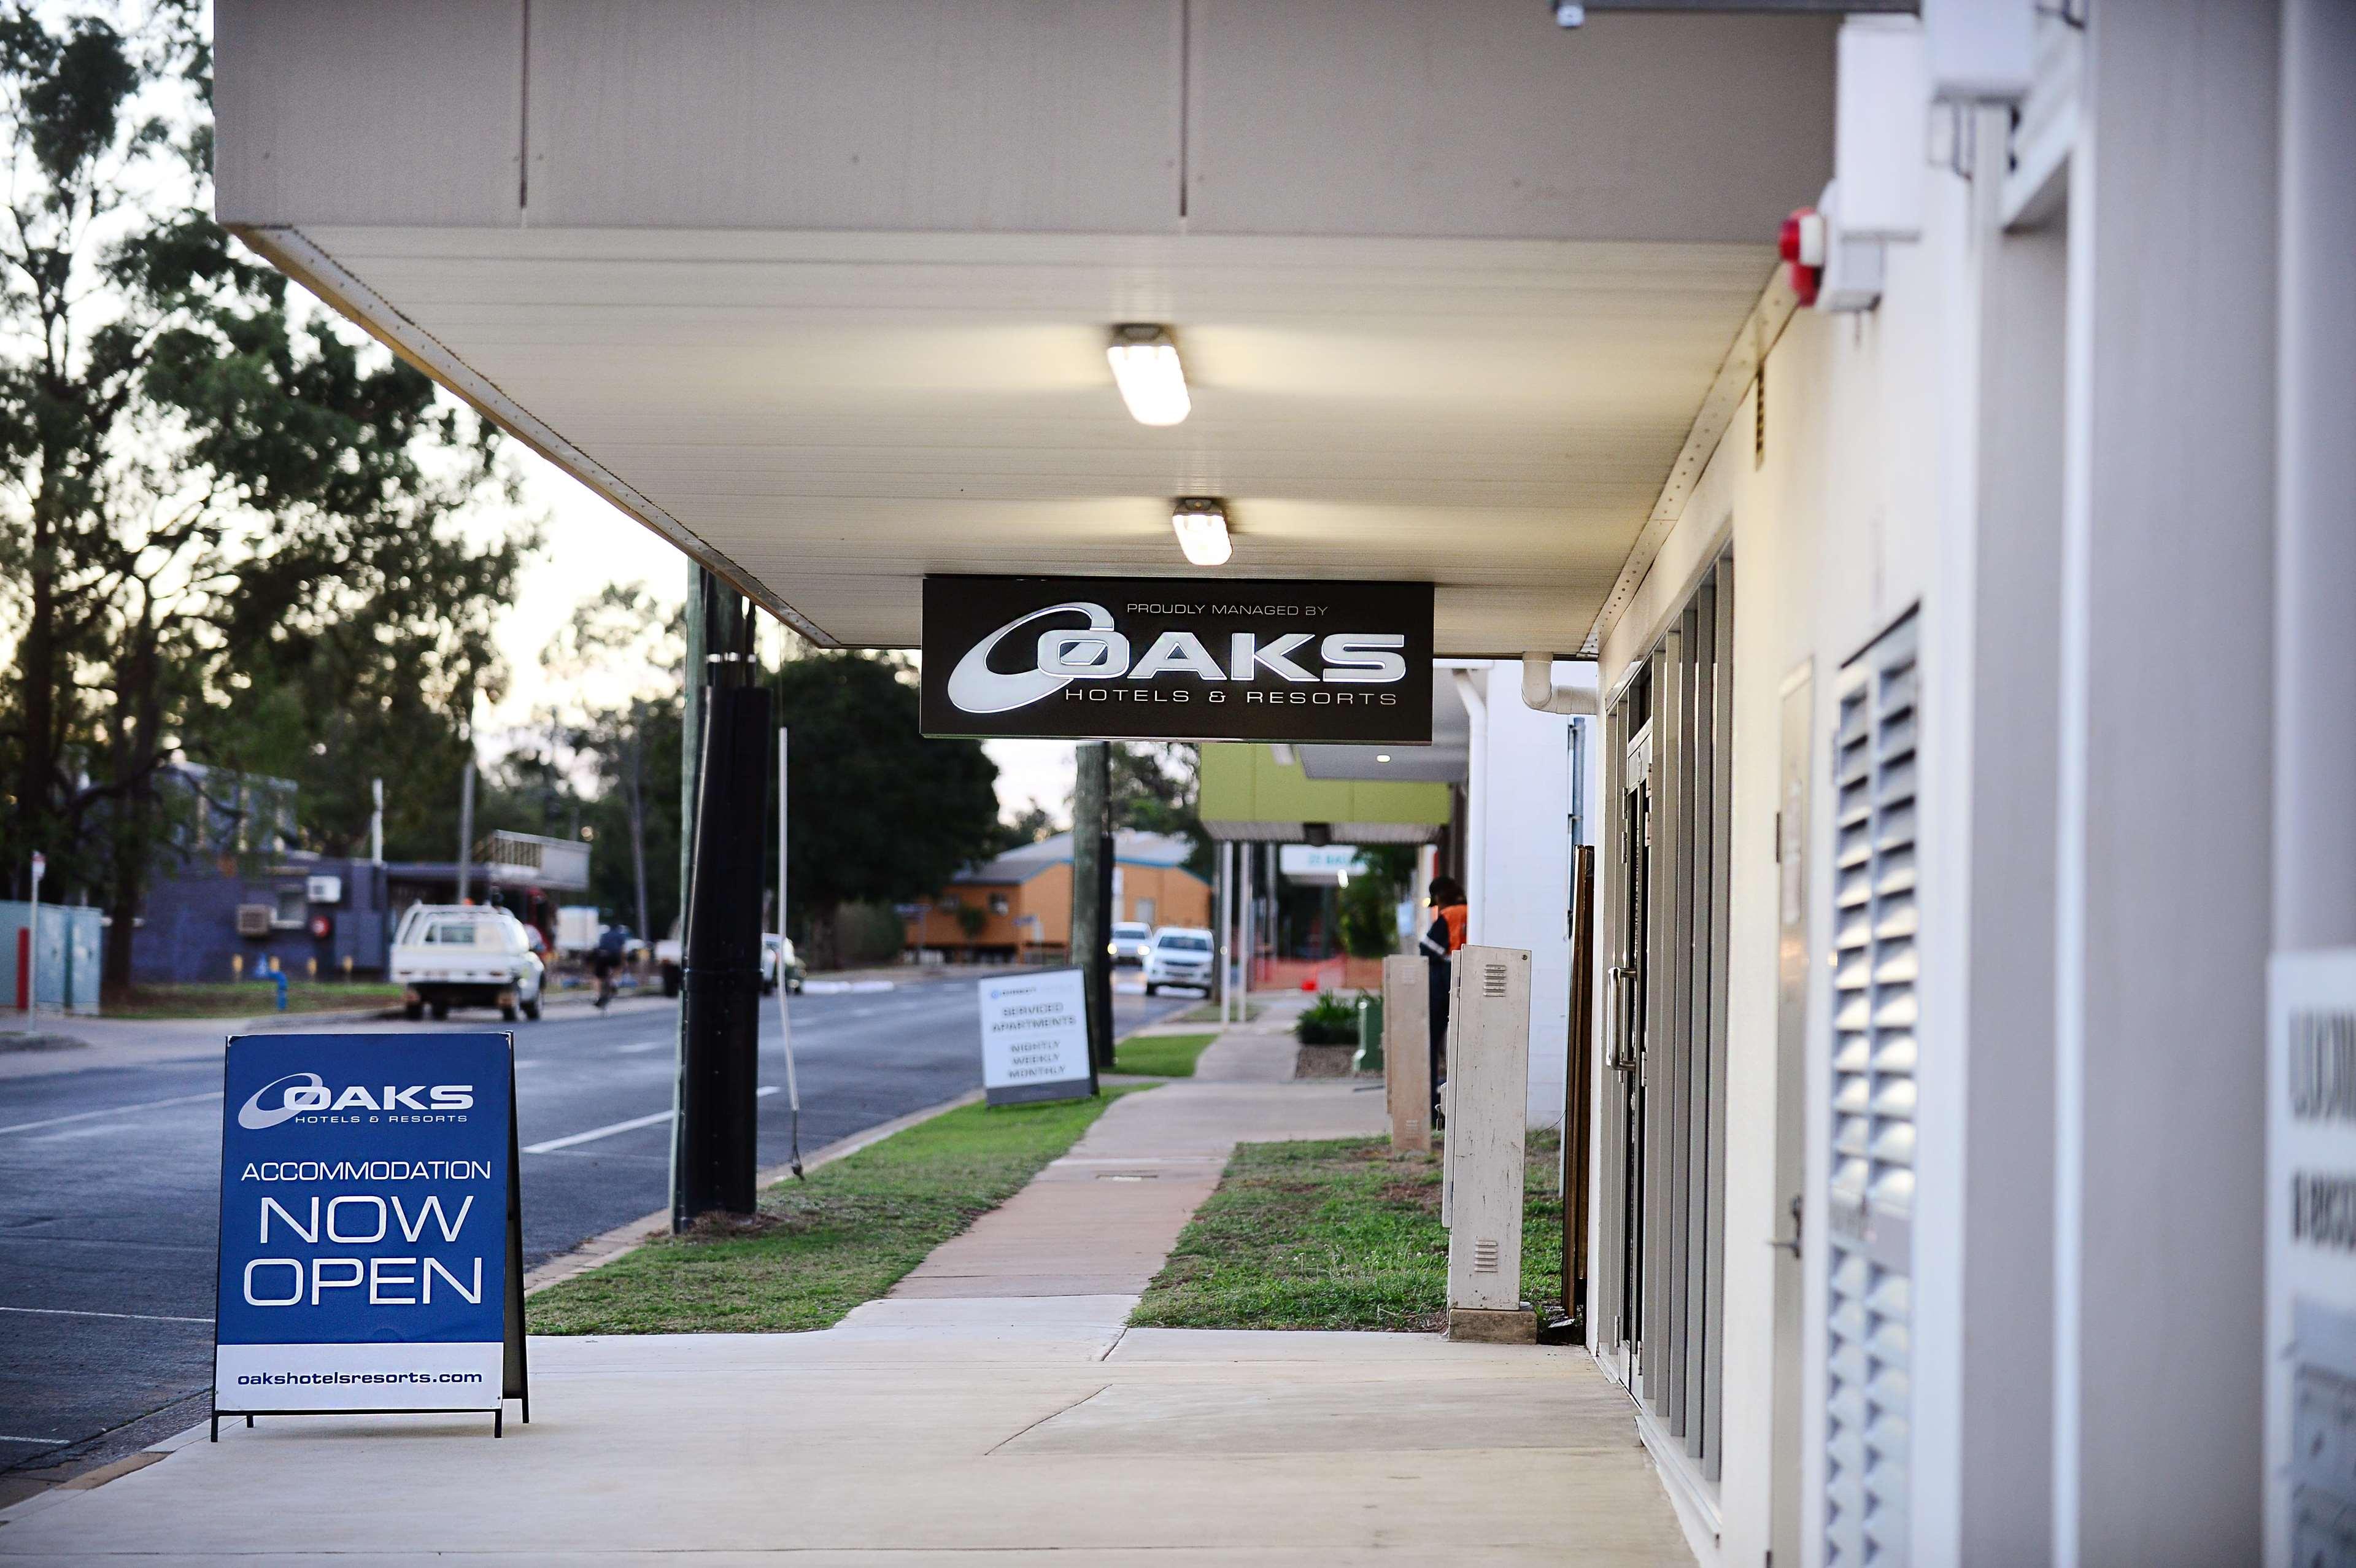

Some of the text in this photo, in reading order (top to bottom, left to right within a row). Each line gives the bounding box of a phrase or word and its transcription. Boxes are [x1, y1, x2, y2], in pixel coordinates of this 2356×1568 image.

[1127, 603, 1328, 617] PROUDLY MANAGED BY
[1037, 630, 1407, 682] OAKS
[1065, 689, 1397, 706] HOTELS & RESORTS
[1003, 1002, 1064, 1016] SERVICED
[992, 1015, 1076, 1032] APARTMENTS
[1010, 1041, 1060, 1052] NIGHTLY
[1012, 1054, 1060, 1065] WEEKLY
[1008, 1065, 1065, 1079] MONTHLY
[283, 1084, 474, 1110] OAKS
[241, 1161, 491, 1182] ACCOMMODATION
[260, 1195, 474, 1243] NOW
[244, 1257, 482, 1307] OPEN
[237, 1370, 482, 1386] oakshotelsresorts.com
